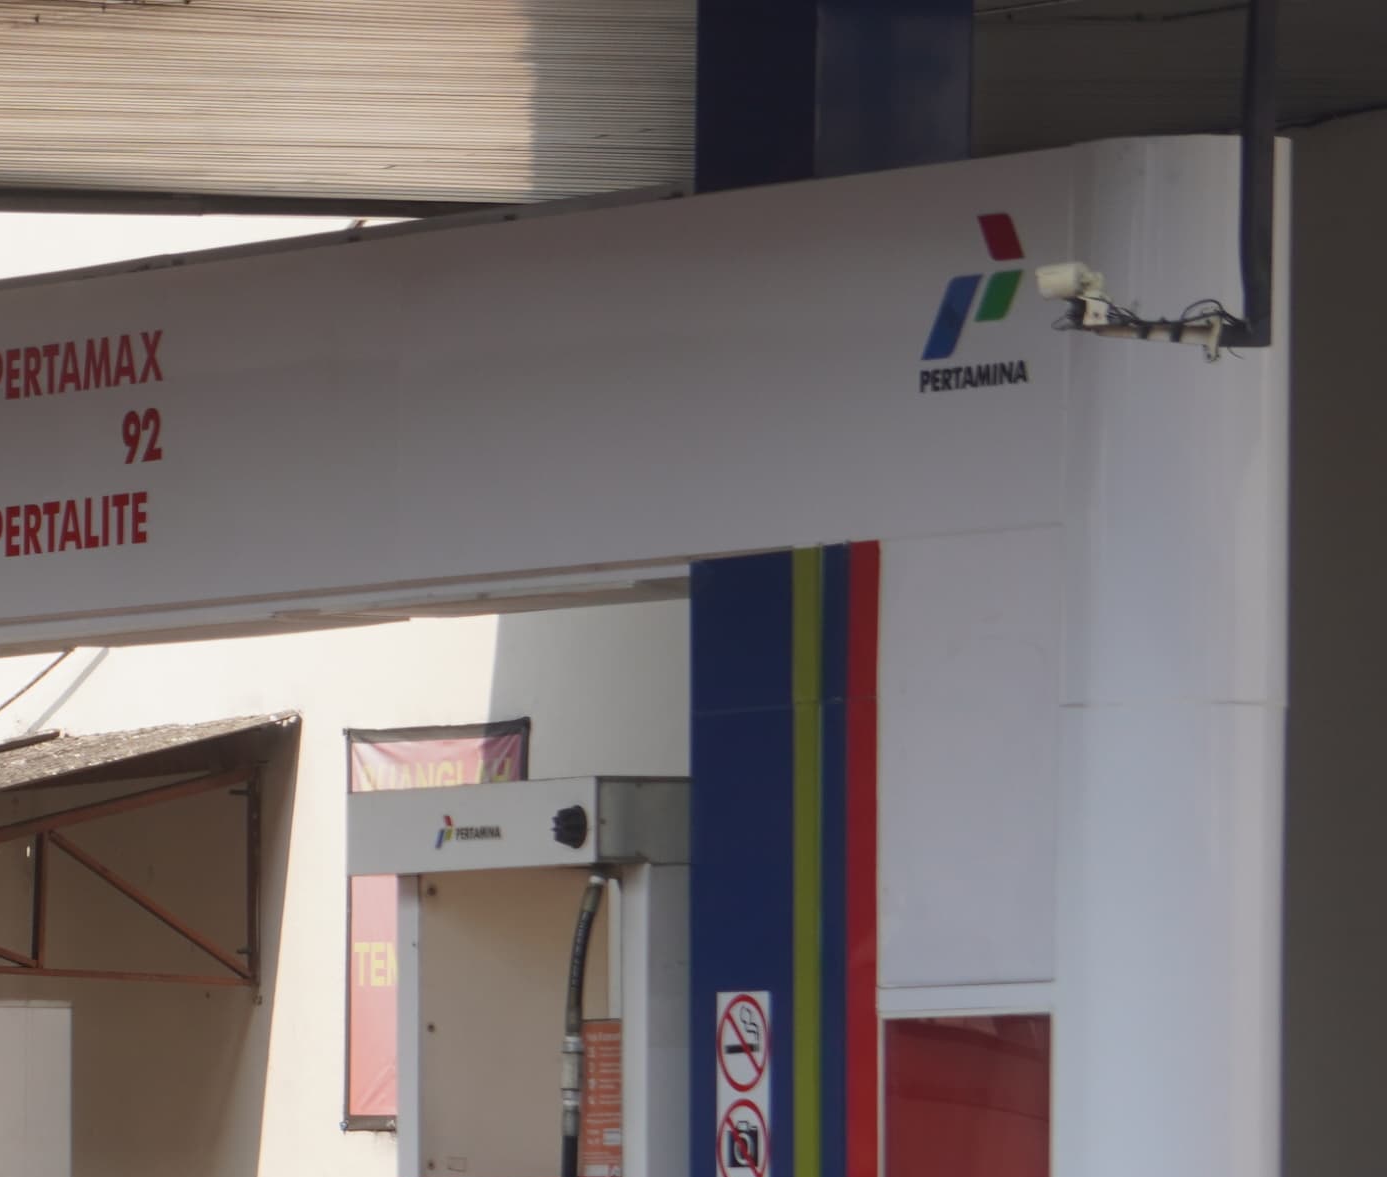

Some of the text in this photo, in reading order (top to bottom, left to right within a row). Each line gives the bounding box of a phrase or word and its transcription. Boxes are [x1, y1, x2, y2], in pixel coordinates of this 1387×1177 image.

[919, 360, 1028, 393] PERTAMINA
[122, 407, 163, 465] 92
[455, 826, 501, 841] PERTAMINA
